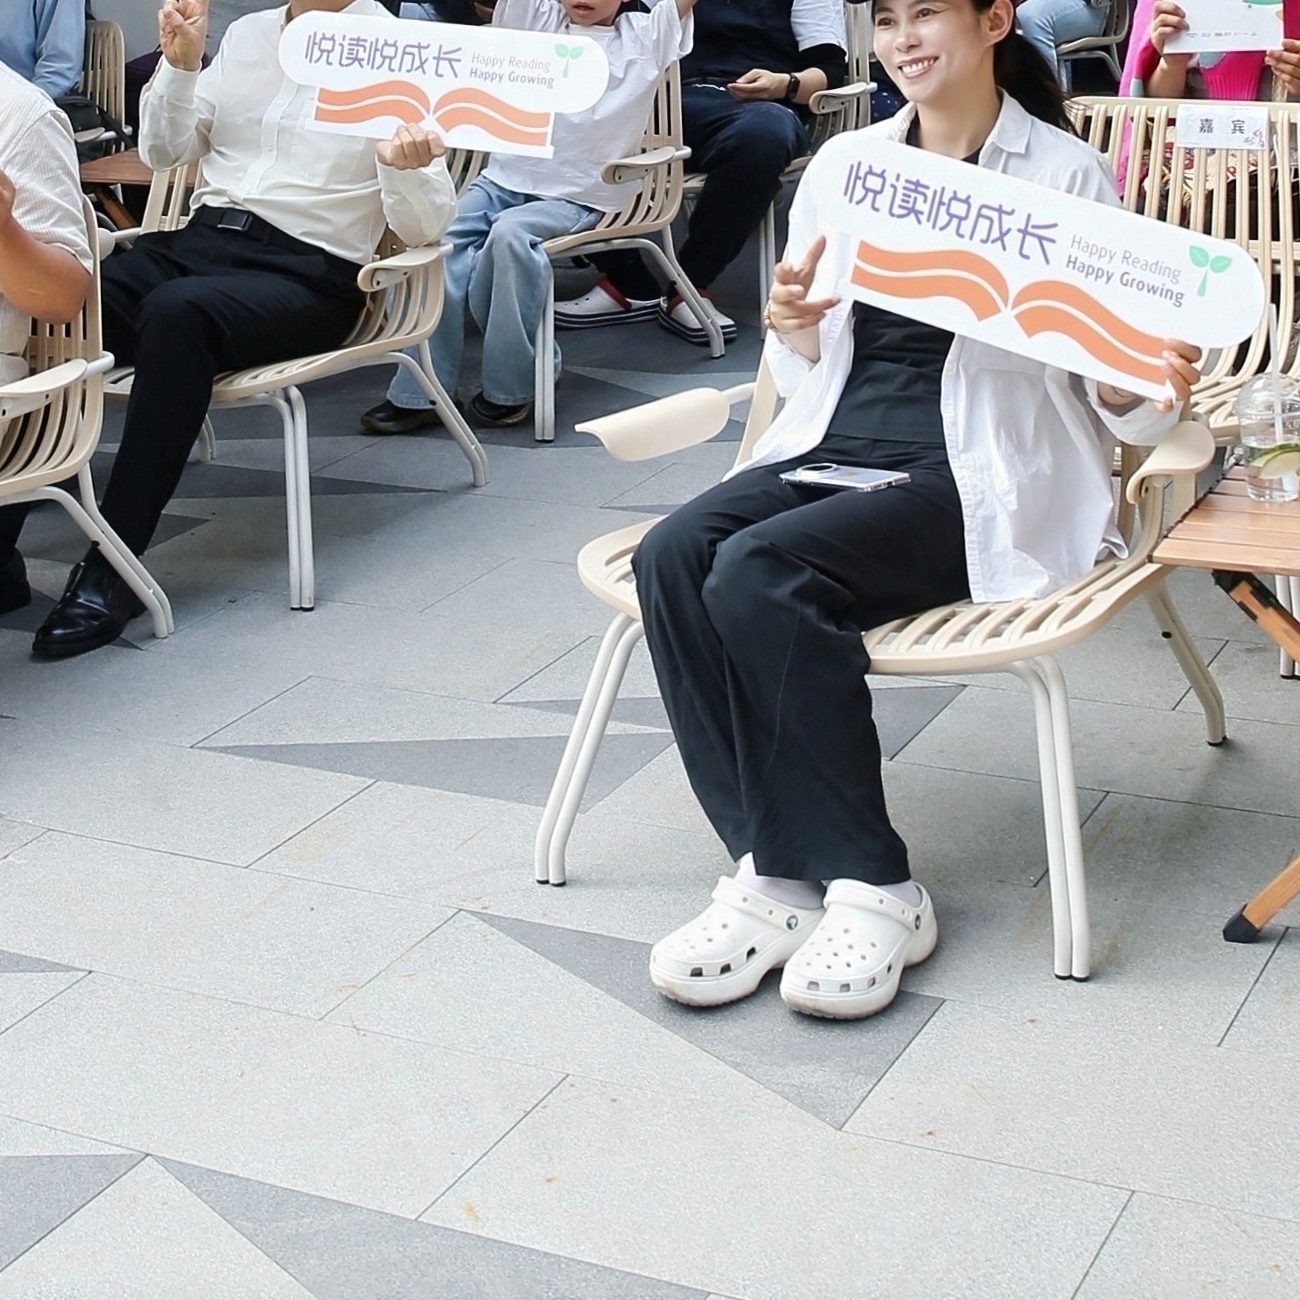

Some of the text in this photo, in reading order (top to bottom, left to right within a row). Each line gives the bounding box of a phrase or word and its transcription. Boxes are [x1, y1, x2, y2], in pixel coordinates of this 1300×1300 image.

[304, 31, 463, 79] 悦读悦成长
[469, 67, 555, 89] Happy Growing
[471, 52, 552, 74] Happy Reading
[1198, 118, 1245, 134] 嘉宾
[843, 160, 1059, 266] 悦读悦成长
[1065, 254, 1186, 307] Happy Growing
[1070, 234, 1183, 285] Happy Reading
